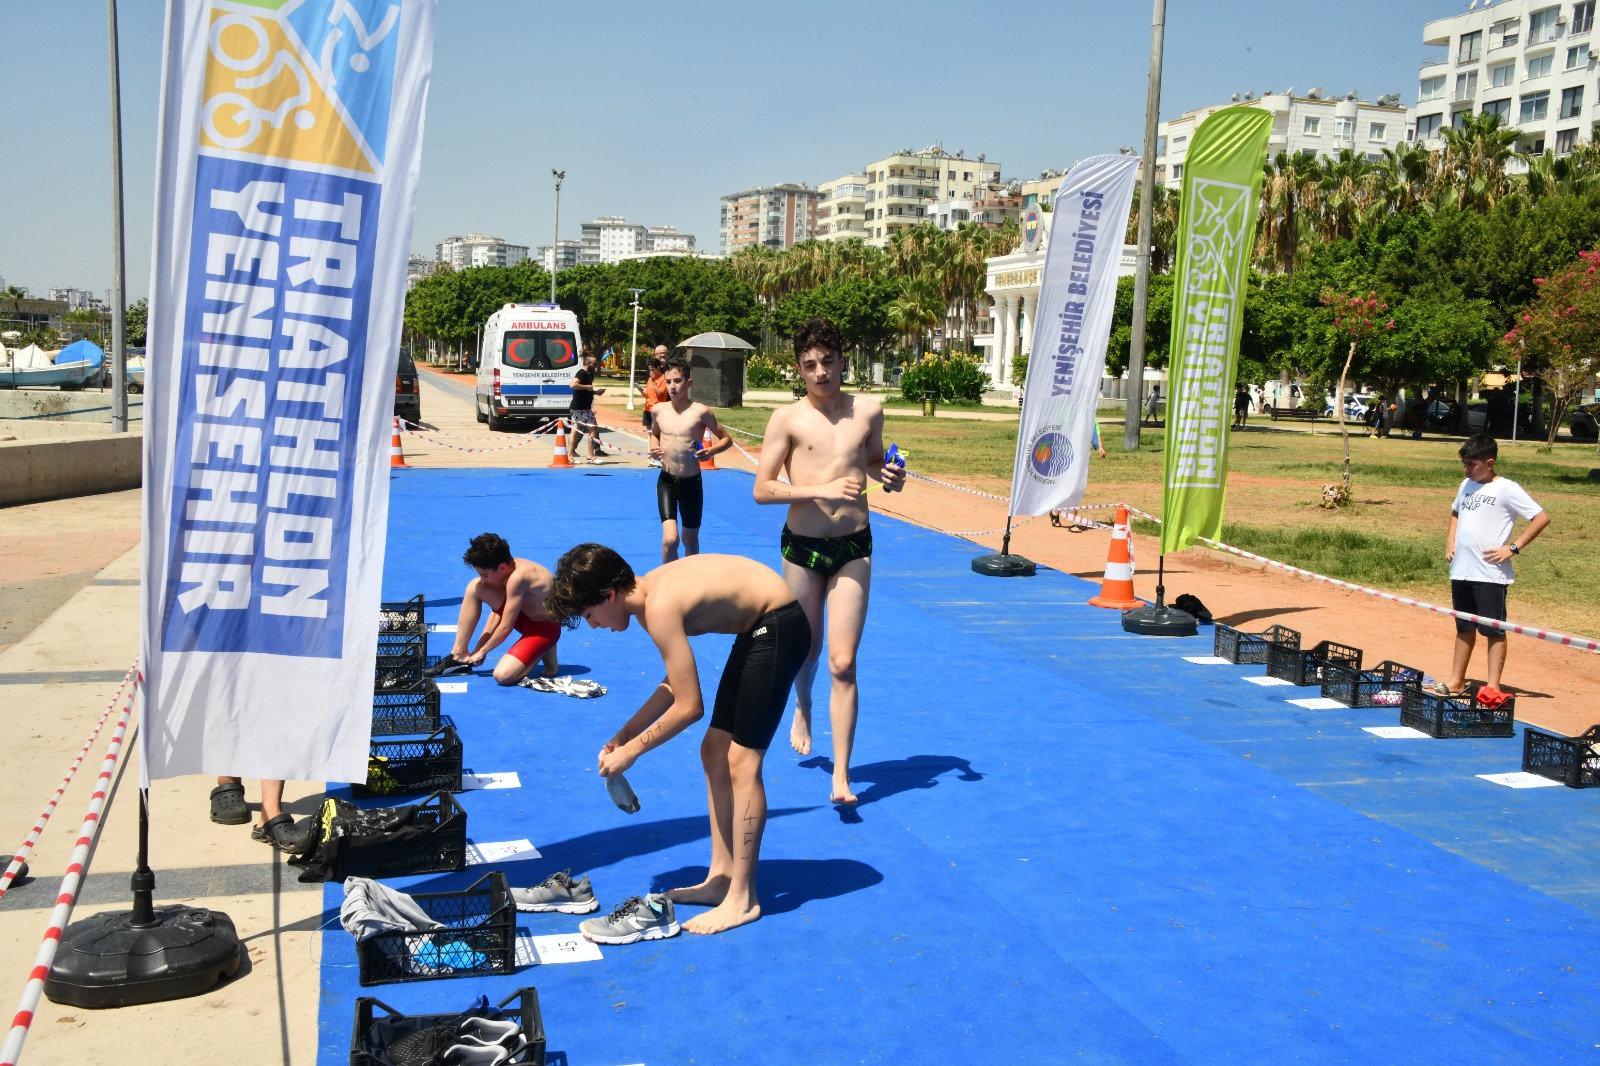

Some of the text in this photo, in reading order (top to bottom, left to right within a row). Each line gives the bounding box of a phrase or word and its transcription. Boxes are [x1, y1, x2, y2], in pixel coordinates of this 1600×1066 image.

[1052, 191, 1104, 397] YENİŞEHİR BELEDİYESİ
[1176, 301, 1208, 478] YENISEHIR
[1197, 302, 1230, 478] TRIATHLON
[178, 181, 285, 614] YENISEHIR
[261, 192, 362, 619] TRIATHLON
